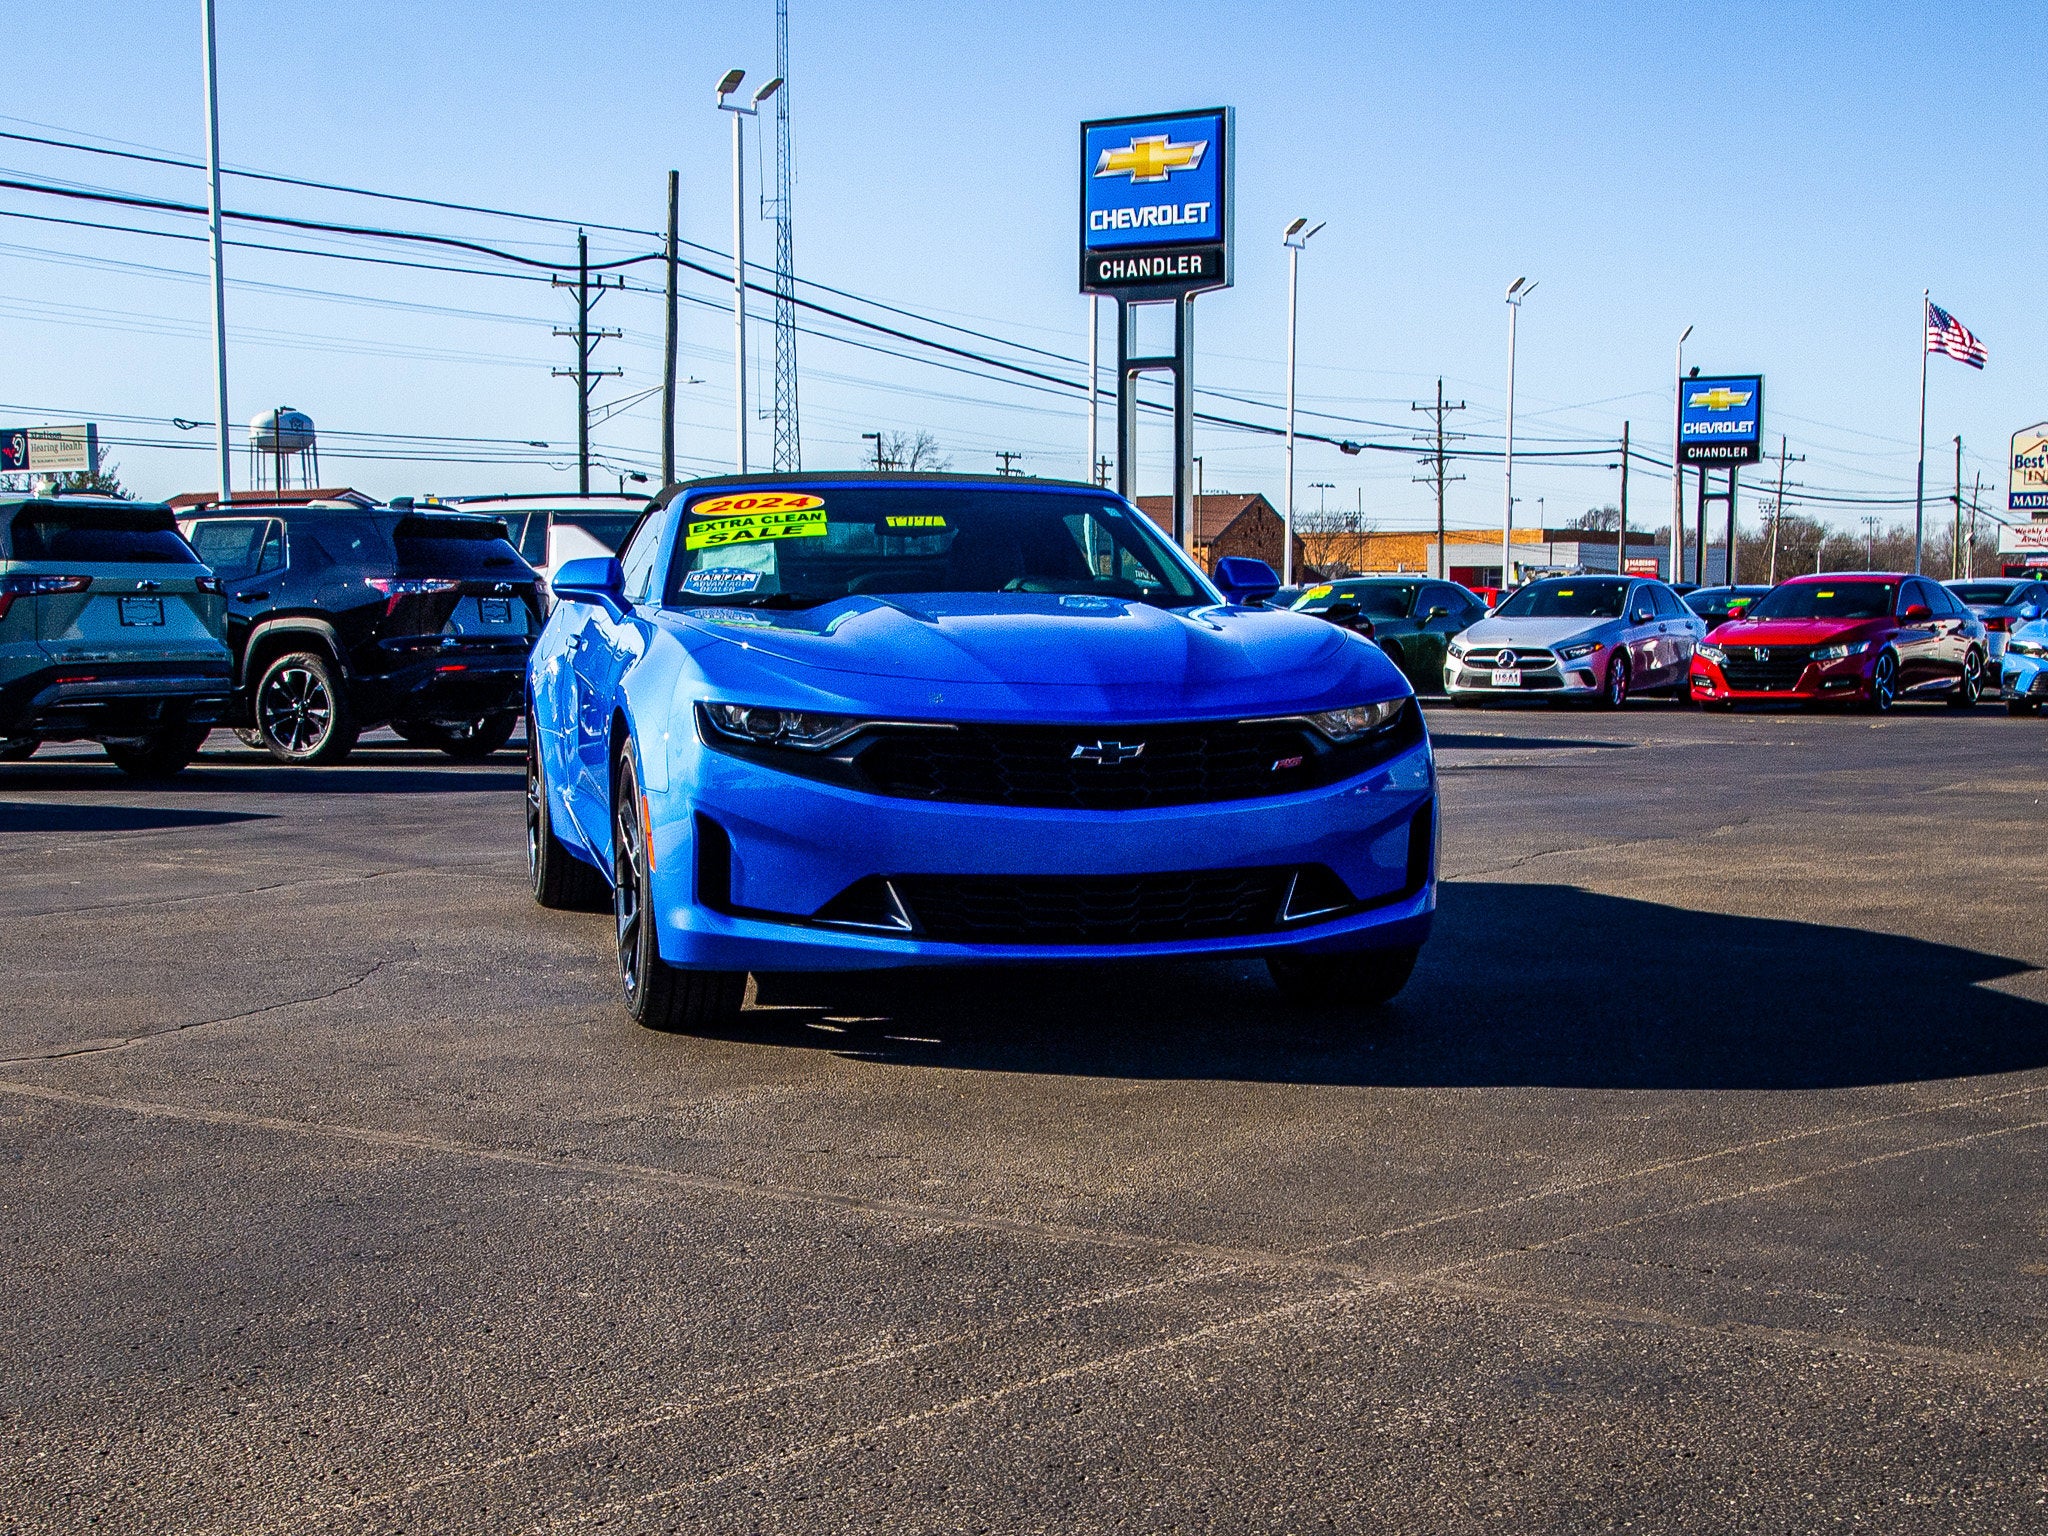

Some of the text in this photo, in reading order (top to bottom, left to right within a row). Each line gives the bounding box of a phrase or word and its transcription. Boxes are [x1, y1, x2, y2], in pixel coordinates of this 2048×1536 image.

[1090, 202, 1210, 230] CHEVROLET
[1100, 255, 1202, 279] CHANDLER
[1683, 421, 1754, 434] CHEVROLET
[31, 441, 83, 454] Hearing Health
[1687, 446, 1748, 458] CHANDLER
[2014, 454, 2045, 469] Best
[706, 497, 810, 513] 2024
[693, 513, 822, 534] EXTRA CLEAN
[705, 524, 804, 544] SALE
